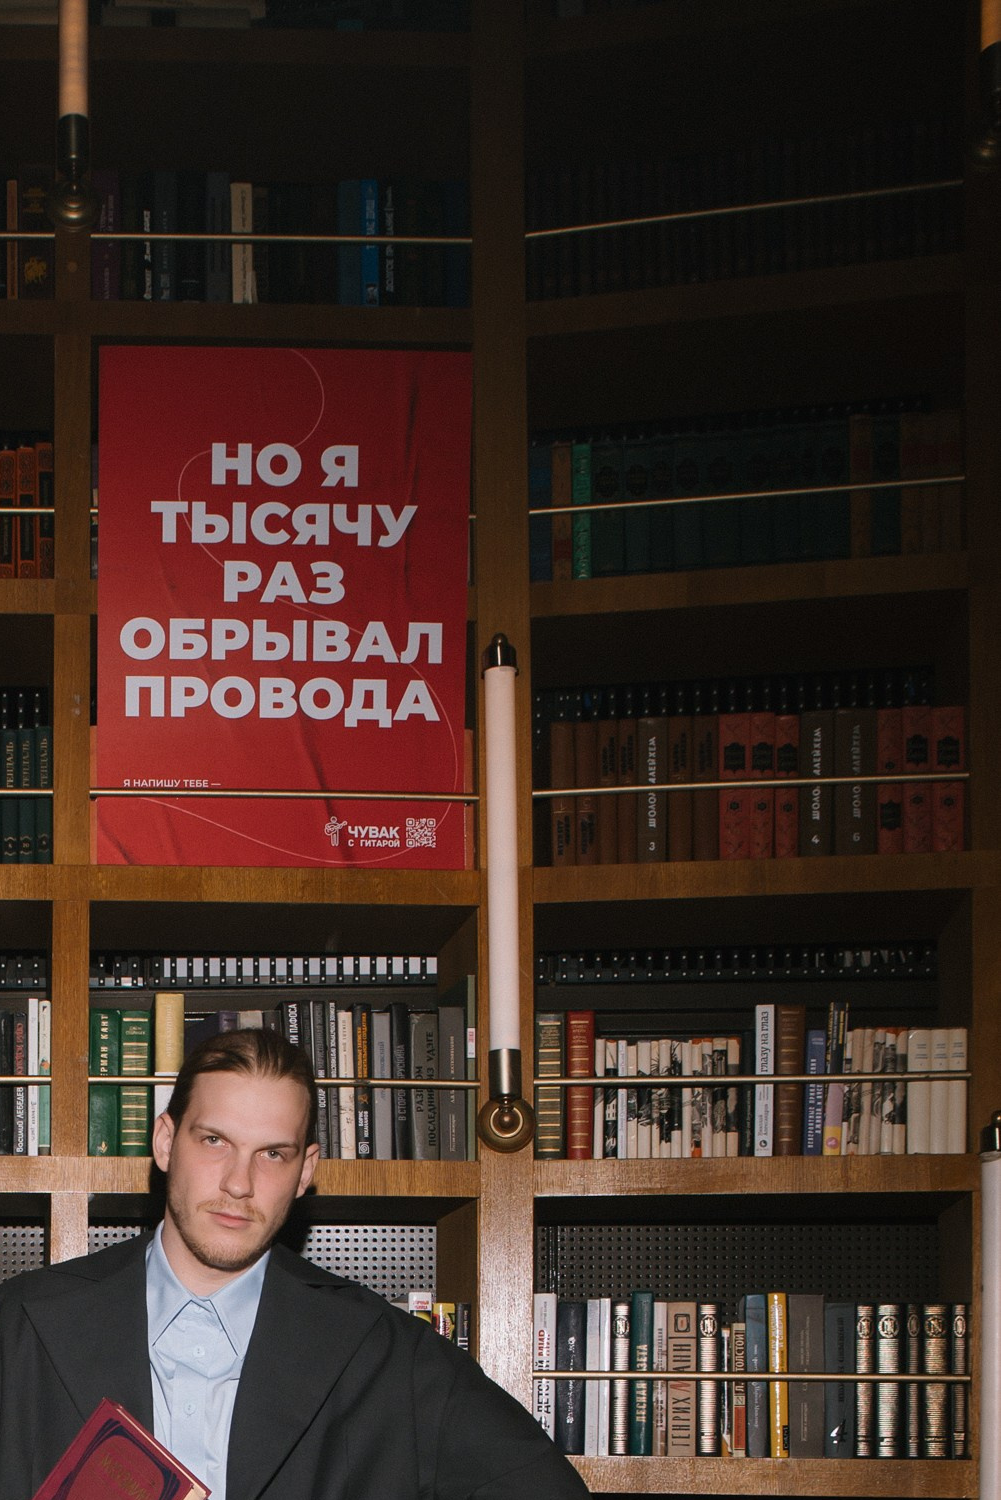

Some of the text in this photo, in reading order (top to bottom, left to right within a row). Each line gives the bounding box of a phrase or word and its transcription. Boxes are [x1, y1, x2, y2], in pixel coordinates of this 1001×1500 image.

[211, 442, 359, 488] НО Я
[150, 500, 419, 549] ТЫСЯЧУ
[222, 560, 346, 605] РАЗ
[119, 617, 443, 664] ОБРЫВАЛ
[124, 676, 441, 729] ПРОВОДА
[123, 778, 209, 788] Я НАПИШУ ТЕБЕ
[348, 826, 400, 839] ЧУВАК
[348, 839, 400, 848] С ГИТАРОЙ
[288, 1003, 299, 1034] ПАФОСА
[759, 1011, 770, 1033] глаз
[99, 1014, 109, 1077] ЕРМАН КАНТ
[424, 1031, 435, 1064] УДЭГЕ
[759, 1047, 772, 1074] глазу
[318, 1088, 327, 1109] ОСКАР
[15, 1087, 27, 1154] Василий ЛЕБЕДЕВ
[734, 1332, 746, 1372] ТОЛСТОЙ
[635, 1382, 648, 1424] ЛЕСНАЯ
[671, 1396, 691, 1448] ГЕНРИХ
